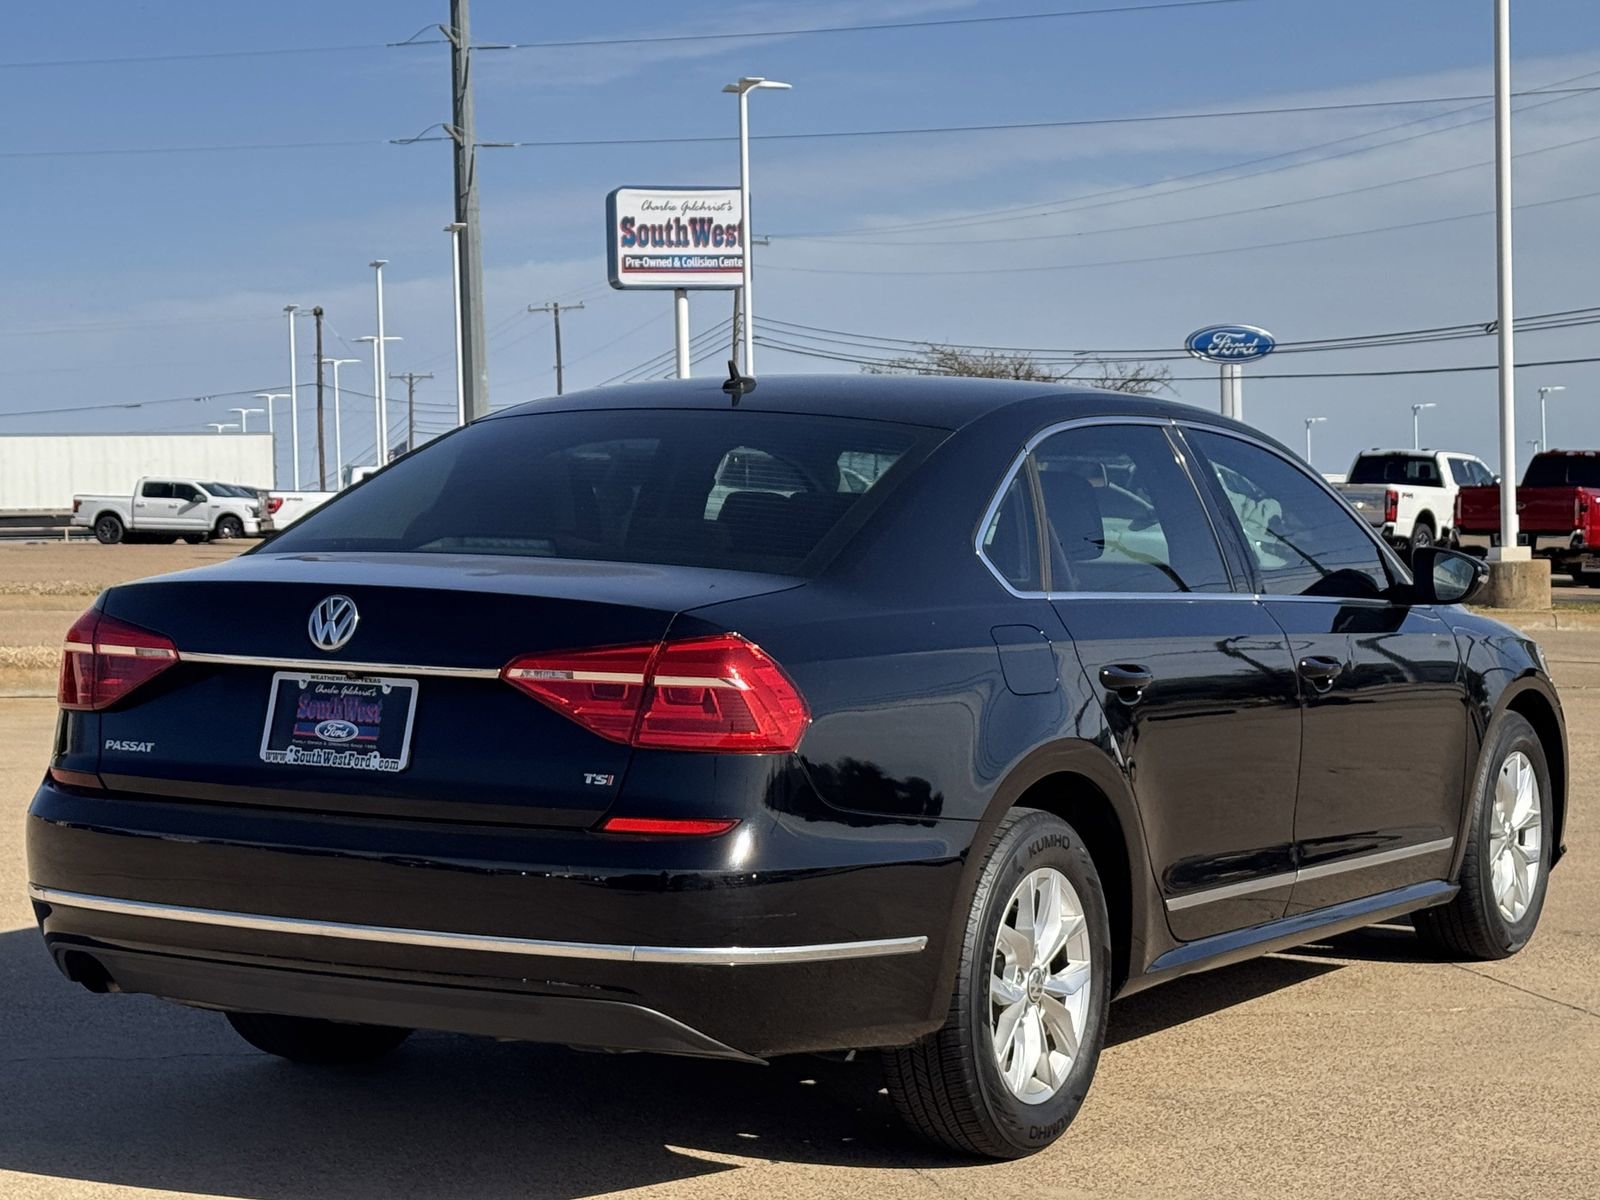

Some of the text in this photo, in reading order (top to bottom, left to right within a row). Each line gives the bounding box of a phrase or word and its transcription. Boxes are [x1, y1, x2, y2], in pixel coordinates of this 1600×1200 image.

[641, 199, 733, 216] Charlie Gilchrist's
[620, 216, 743, 248] SouthWest
[625, 257, 743, 268] Pre-Owned & Collision Cente
[1208, 332, 1259, 355] Ford
[296, 694, 382, 723] SouthWest
[323, 723, 348, 738] Ford
[105, 739, 155, 752] PASSAT
[265, 749, 399, 770] www.SouthWestFord.com
[1028, 834, 1070, 858] KUMHO
